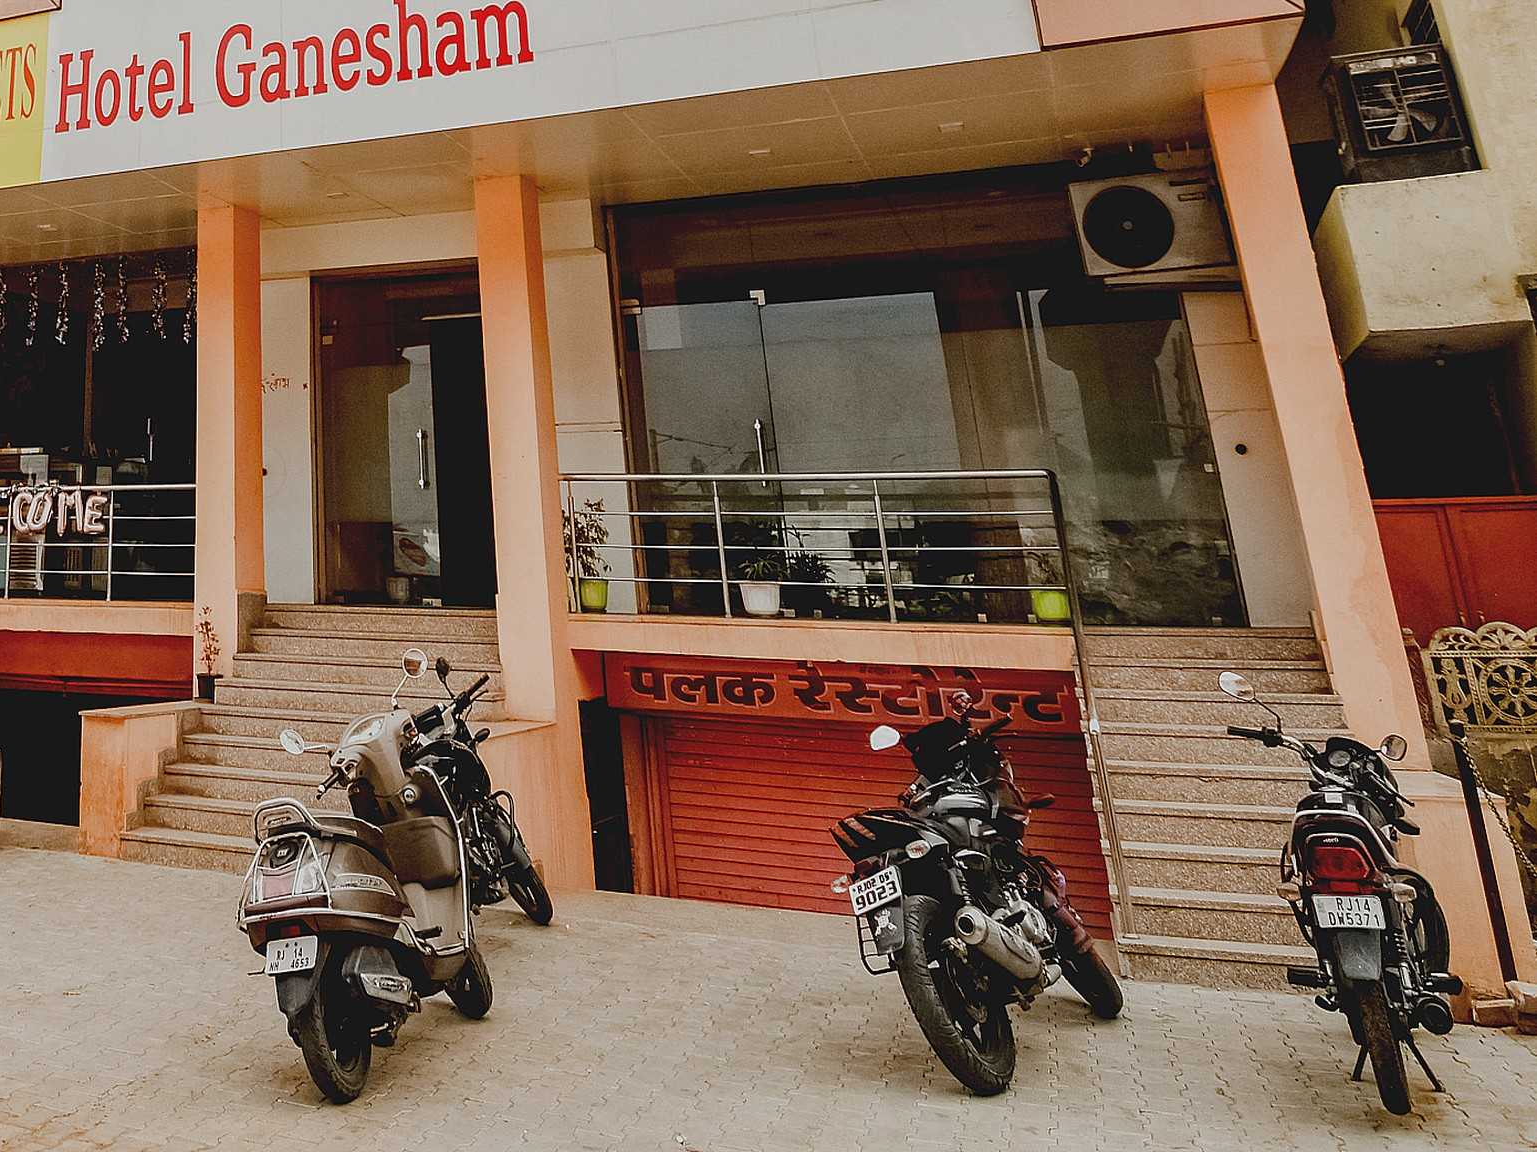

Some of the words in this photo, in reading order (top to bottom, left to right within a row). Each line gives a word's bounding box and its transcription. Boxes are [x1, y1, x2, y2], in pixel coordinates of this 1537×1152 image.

[55, 32, 195, 134] Hotel
[624, 664, 775, 708] पलक
[857, 878, 876, 894] RJ02
[855, 881, 897, 910] 9023
[1335, 897, 1370, 912] RJ14
[276, 950, 285, 961] RJ
[294, 947, 303, 958] 14
[290, 957, 309, 969] 4653
